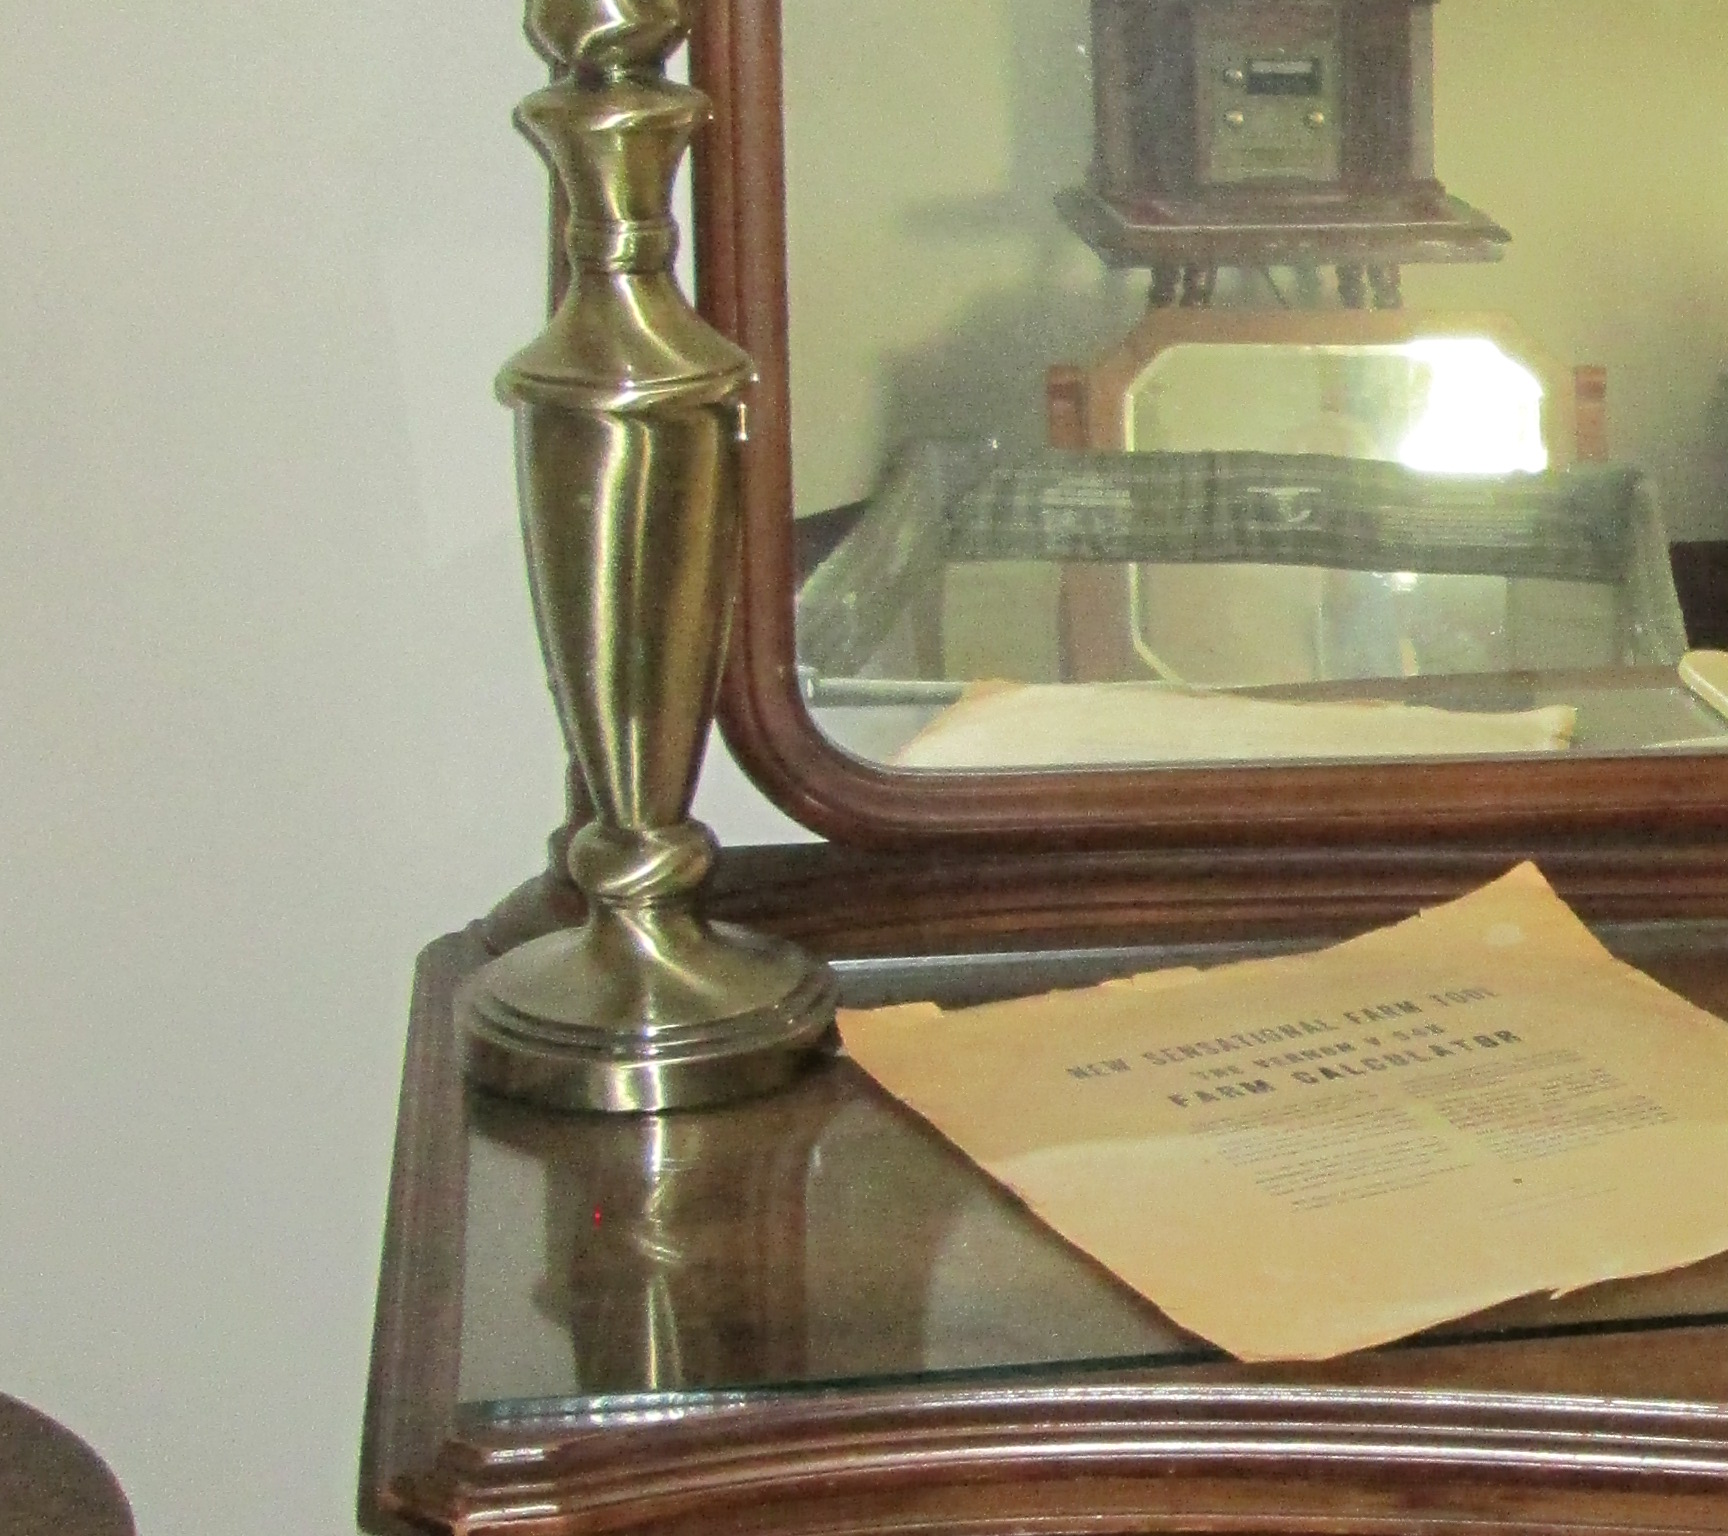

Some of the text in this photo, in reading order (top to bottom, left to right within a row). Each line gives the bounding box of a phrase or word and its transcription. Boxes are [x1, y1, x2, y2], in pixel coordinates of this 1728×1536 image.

[1065, 987, 1499, 1080] NEW SENSATIONAL FARM TOOL
[1167, 1029, 1523, 1108] FARM CALCULATOR
[1190, 1064, 1244, 1080] THE
